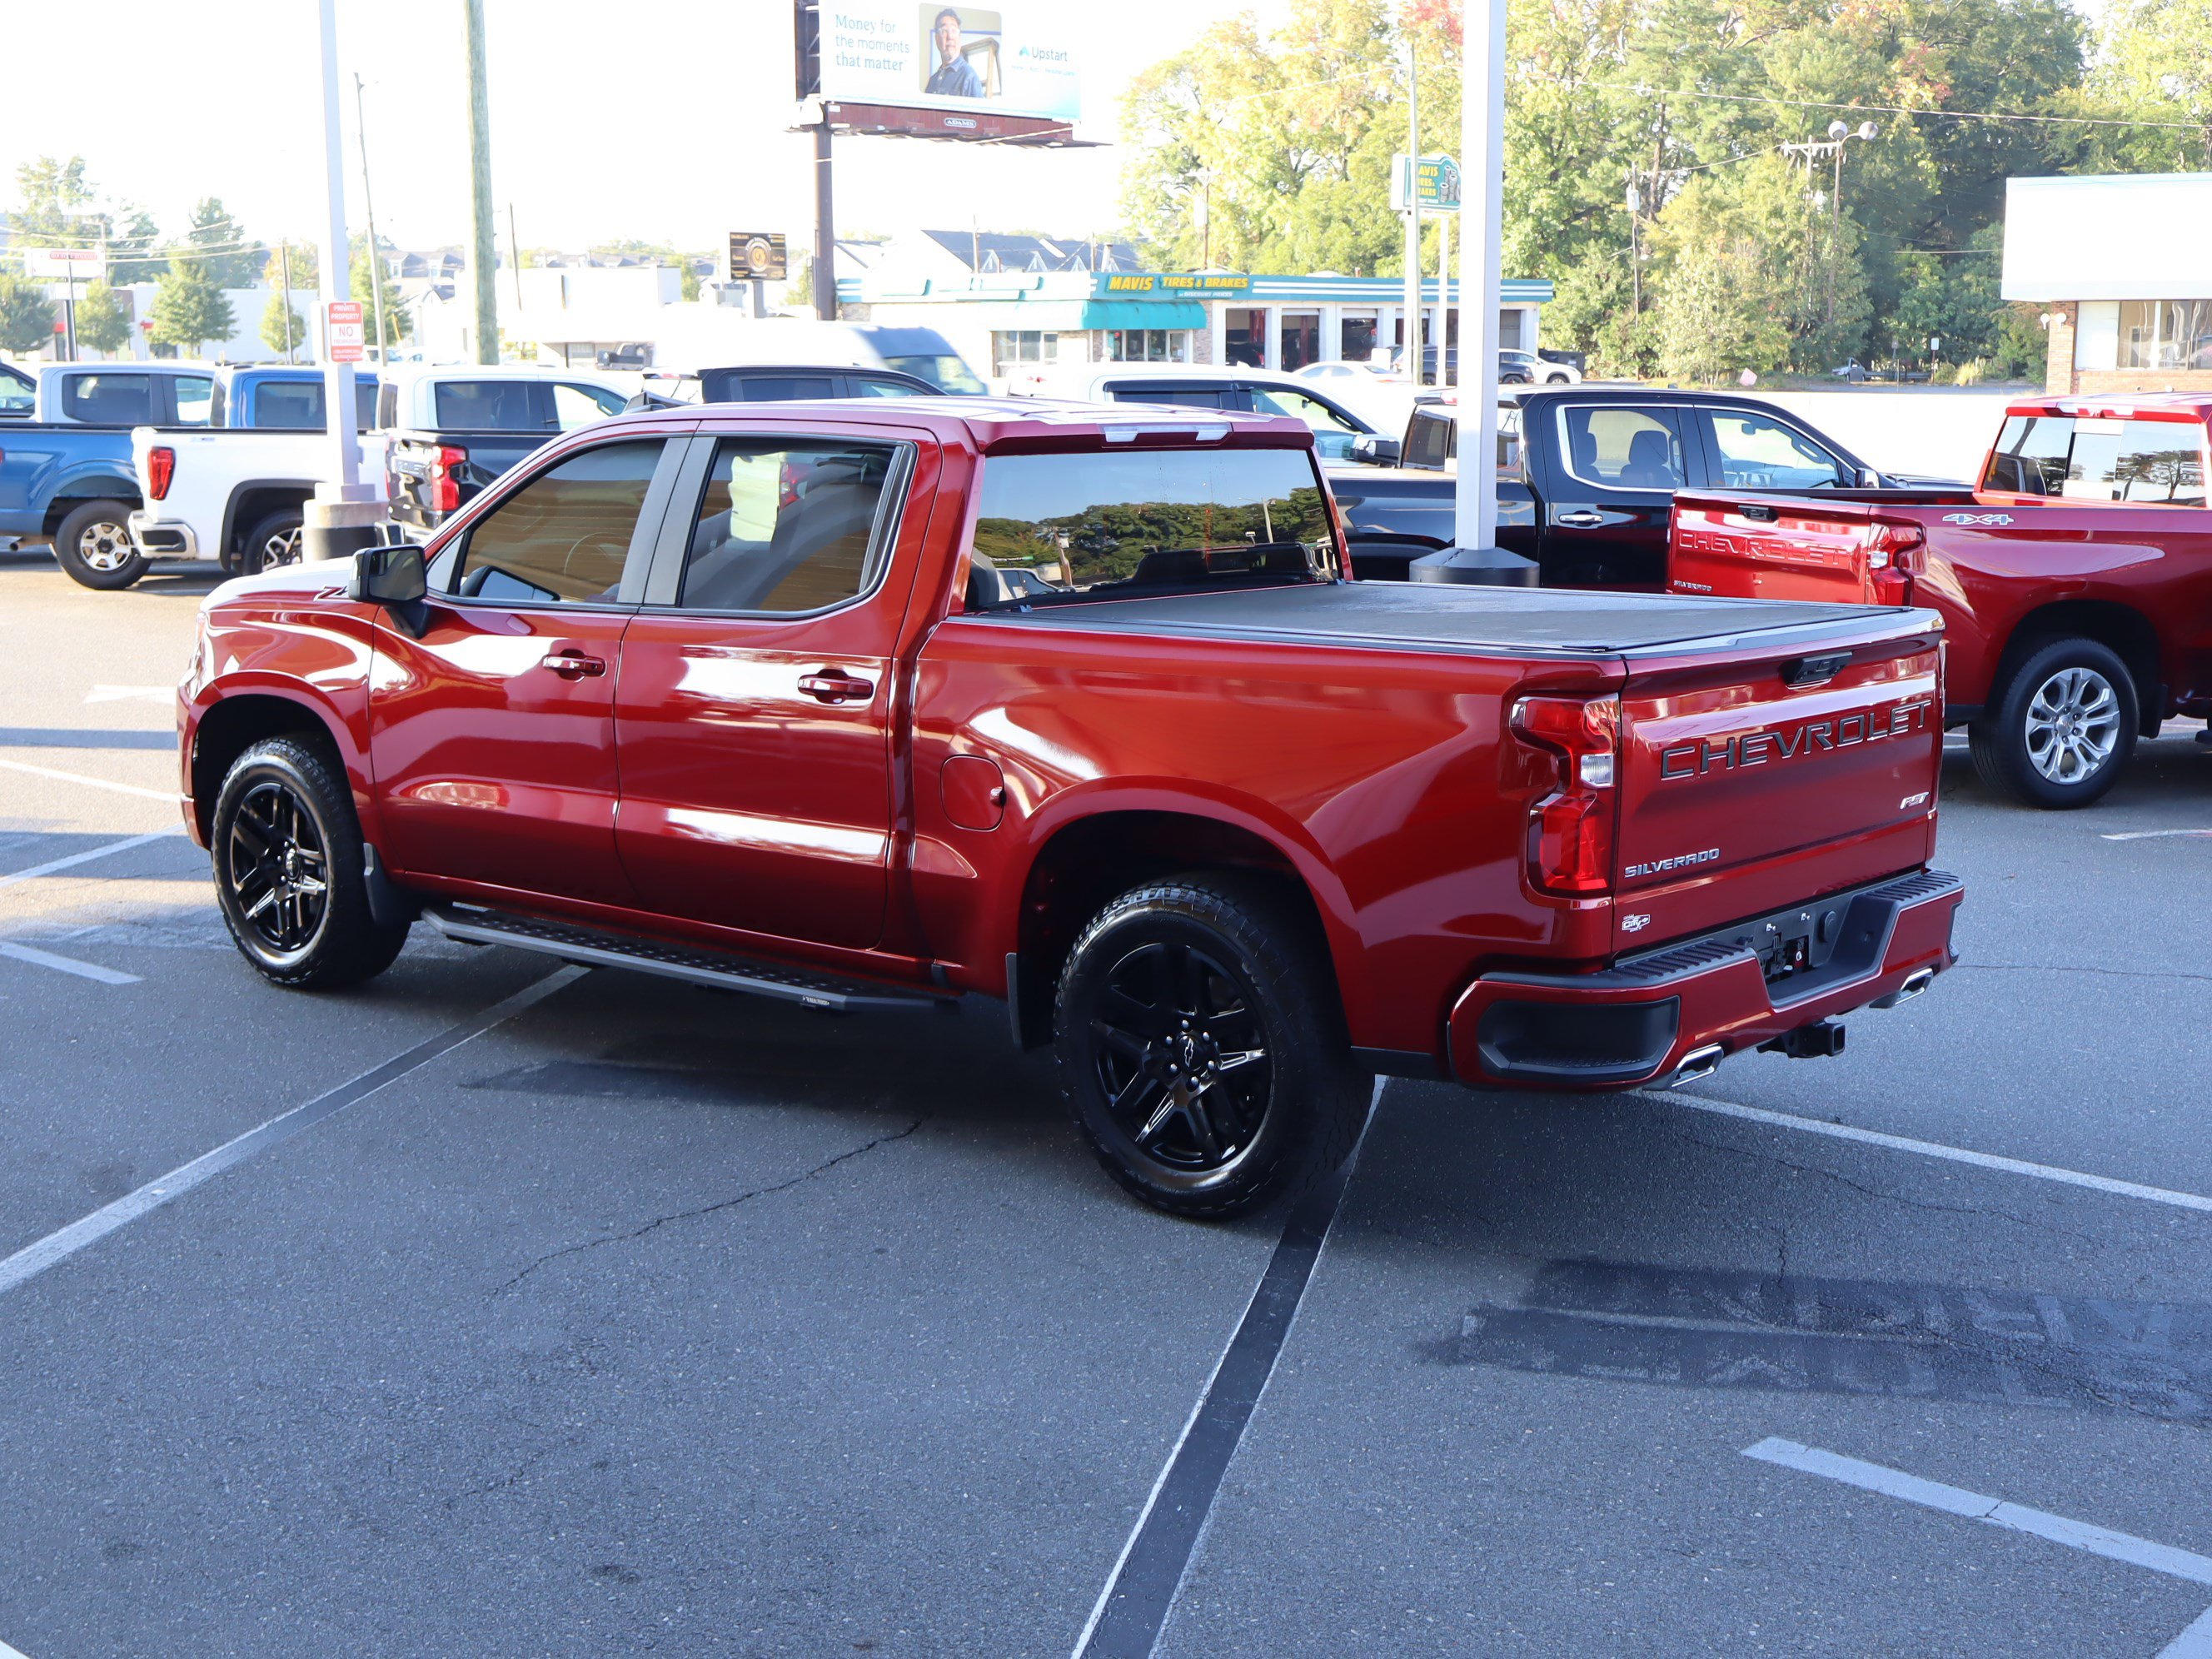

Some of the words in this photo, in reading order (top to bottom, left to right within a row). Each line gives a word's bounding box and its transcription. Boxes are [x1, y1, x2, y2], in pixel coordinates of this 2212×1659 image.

[835, 14, 876, 34] Money
[880, 19, 896, 33] for
[835, 34, 854, 47] the
[858, 38, 910, 53] moments
[835, 52, 861, 67] that
[864, 57, 904, 71] matter
[1032, 47, 1068, 62] Upstart
[1419, 165, 1439, 177] AVIS
[1109, 276, 1153, 290] MAVIS
[1163, 276, 1194, 287] TIRES
[1205, 277, 1248, 288] BRAKES
[339, 326, 353, 337] NO
[1679, 533, 1849, 565] CHEVROLET
[1673, 580, 1712, 591] SILVERADO
[1661, 700, 1932, 781] CHEVROLET
[1624, 848, 1720, 879] SILVERADO
